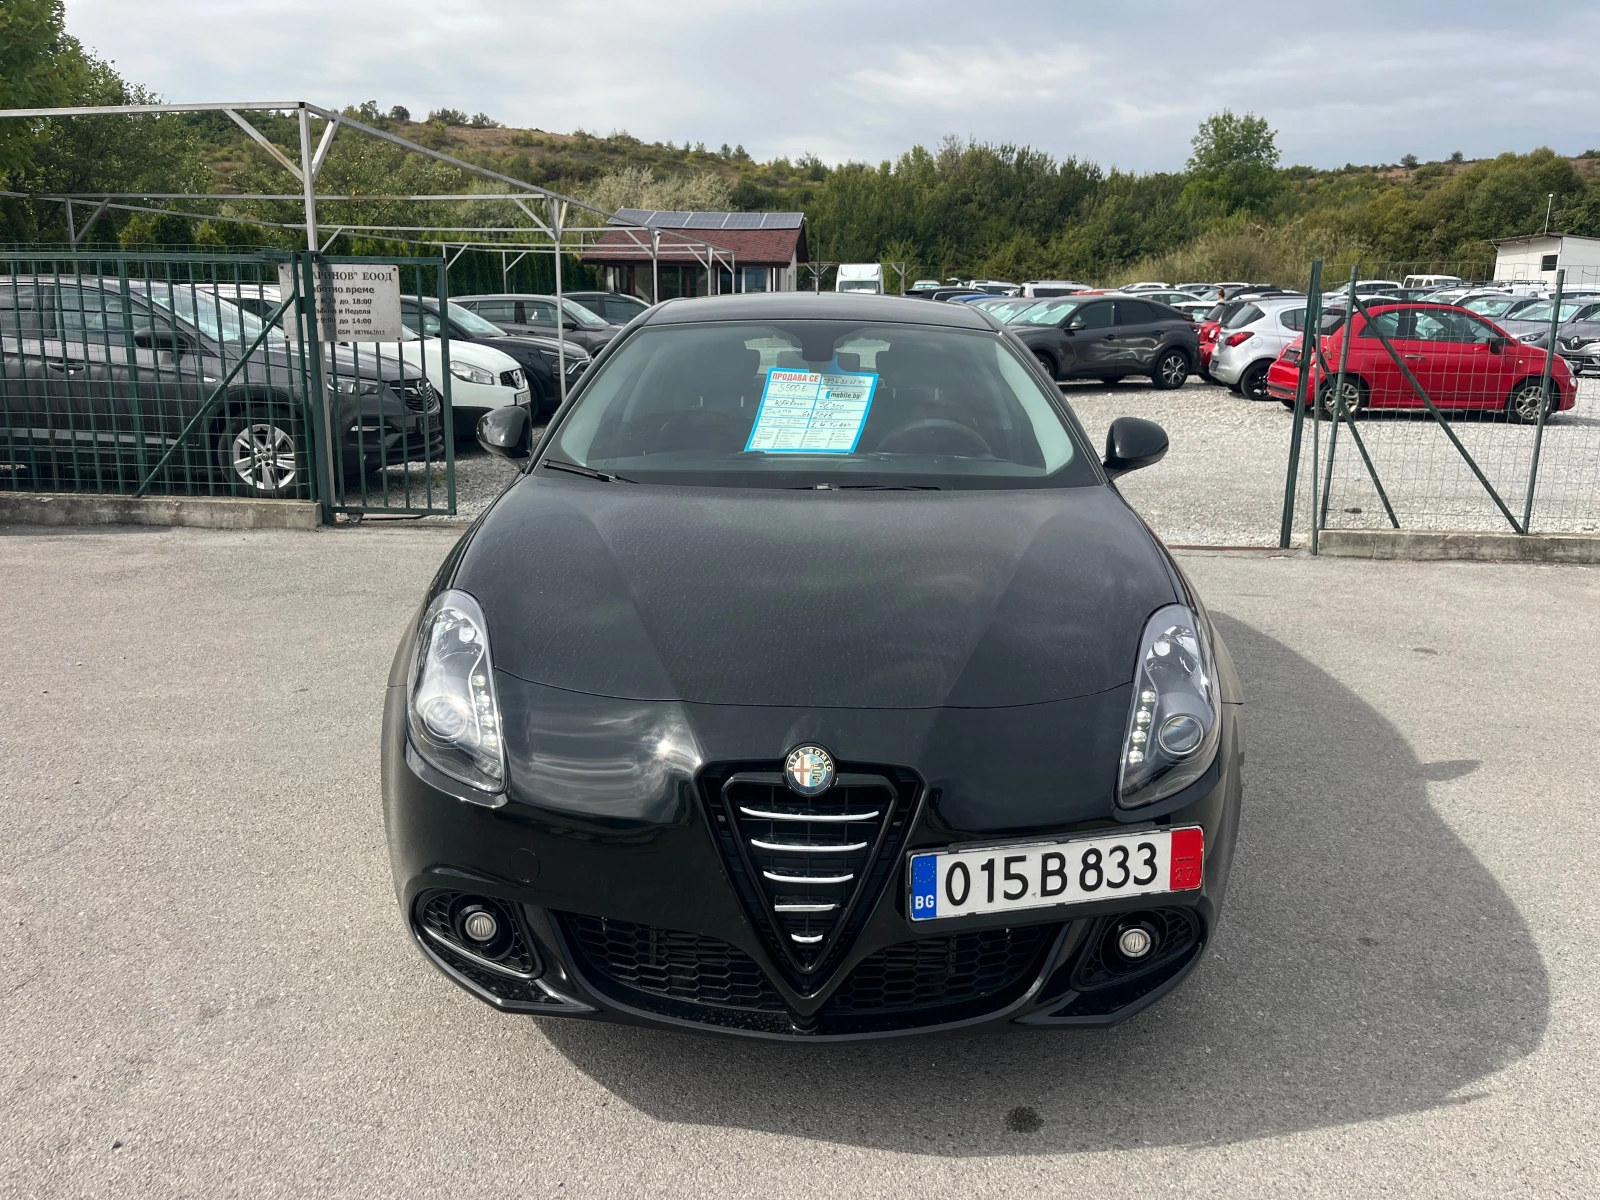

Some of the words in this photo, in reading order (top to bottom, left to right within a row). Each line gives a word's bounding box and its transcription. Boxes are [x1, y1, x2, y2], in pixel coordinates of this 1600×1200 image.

[362, 272, 393, 282] ЕООД
[346, 287, 375, 295] време
[772, 373, 807, 382] ПРОДАВА
[809, 374, 819, 383] СЕ
[830, 392, 861, 400] mobile.bg
[788, 750, 804, 772] ALFA
[808, 748, 832, 772] ROMEO
[1175, 866, 1195, 883] 27
[914, 895, 935, 910] BG
